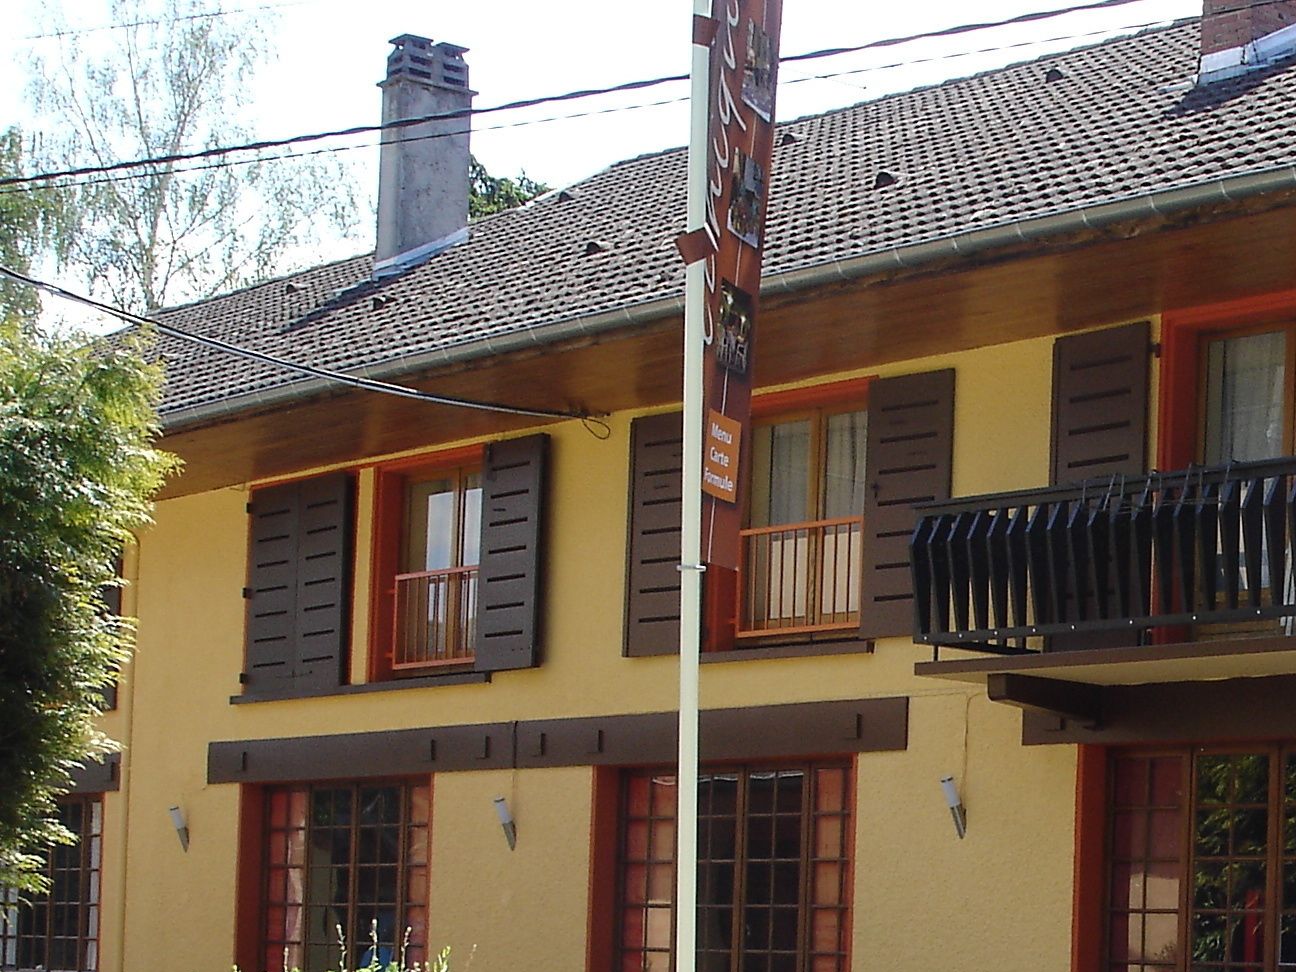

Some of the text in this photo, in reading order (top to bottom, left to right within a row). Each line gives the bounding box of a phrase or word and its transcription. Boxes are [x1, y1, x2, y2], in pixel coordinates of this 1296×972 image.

[711, 422, 732, 444] Menu
[710, 446, 729, 467] Carte
[704, 467, 733, 492] Formule
